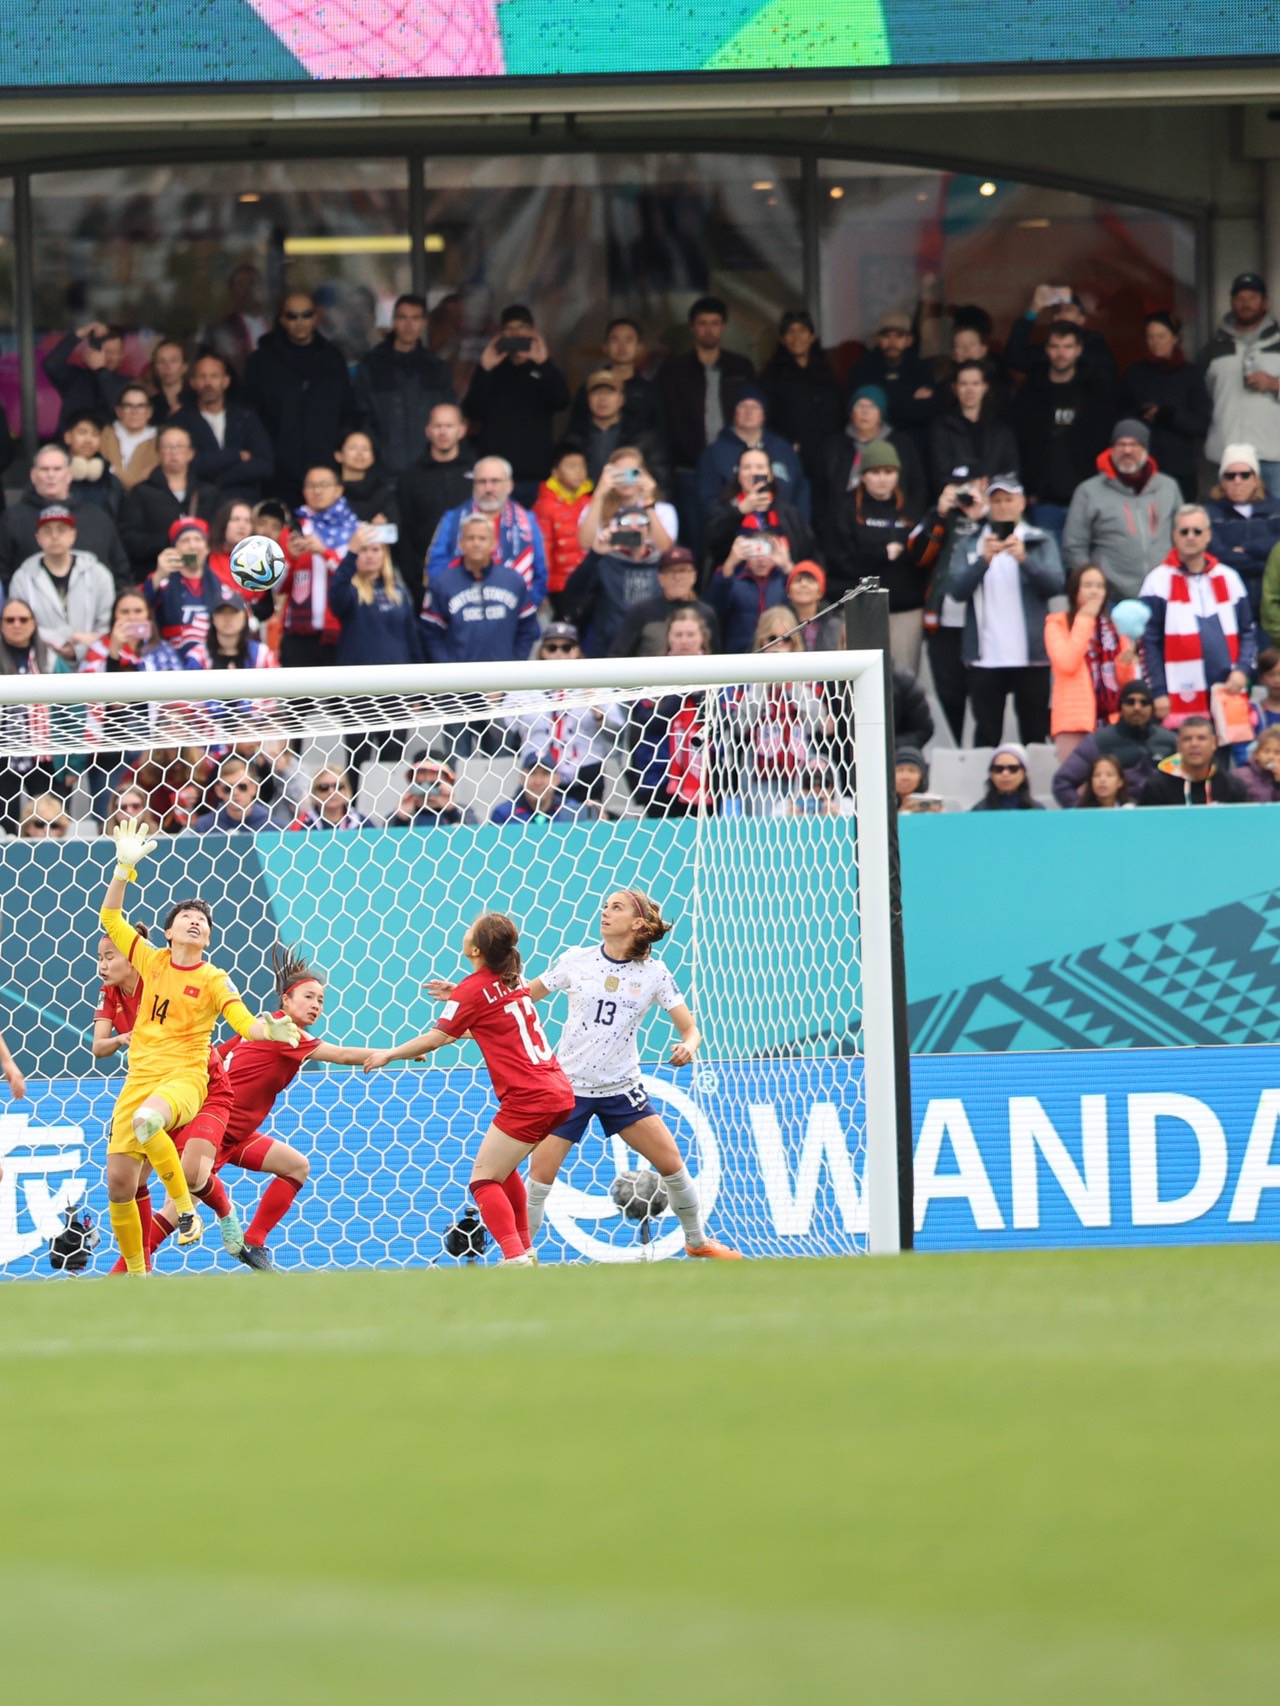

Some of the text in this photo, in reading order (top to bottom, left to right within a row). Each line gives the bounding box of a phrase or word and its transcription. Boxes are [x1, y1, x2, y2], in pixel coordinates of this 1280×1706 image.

[151, 994, 170, 1025] 14
[594, 999, 617, 1026] 13
[504, 996, 553, 1064] 13
